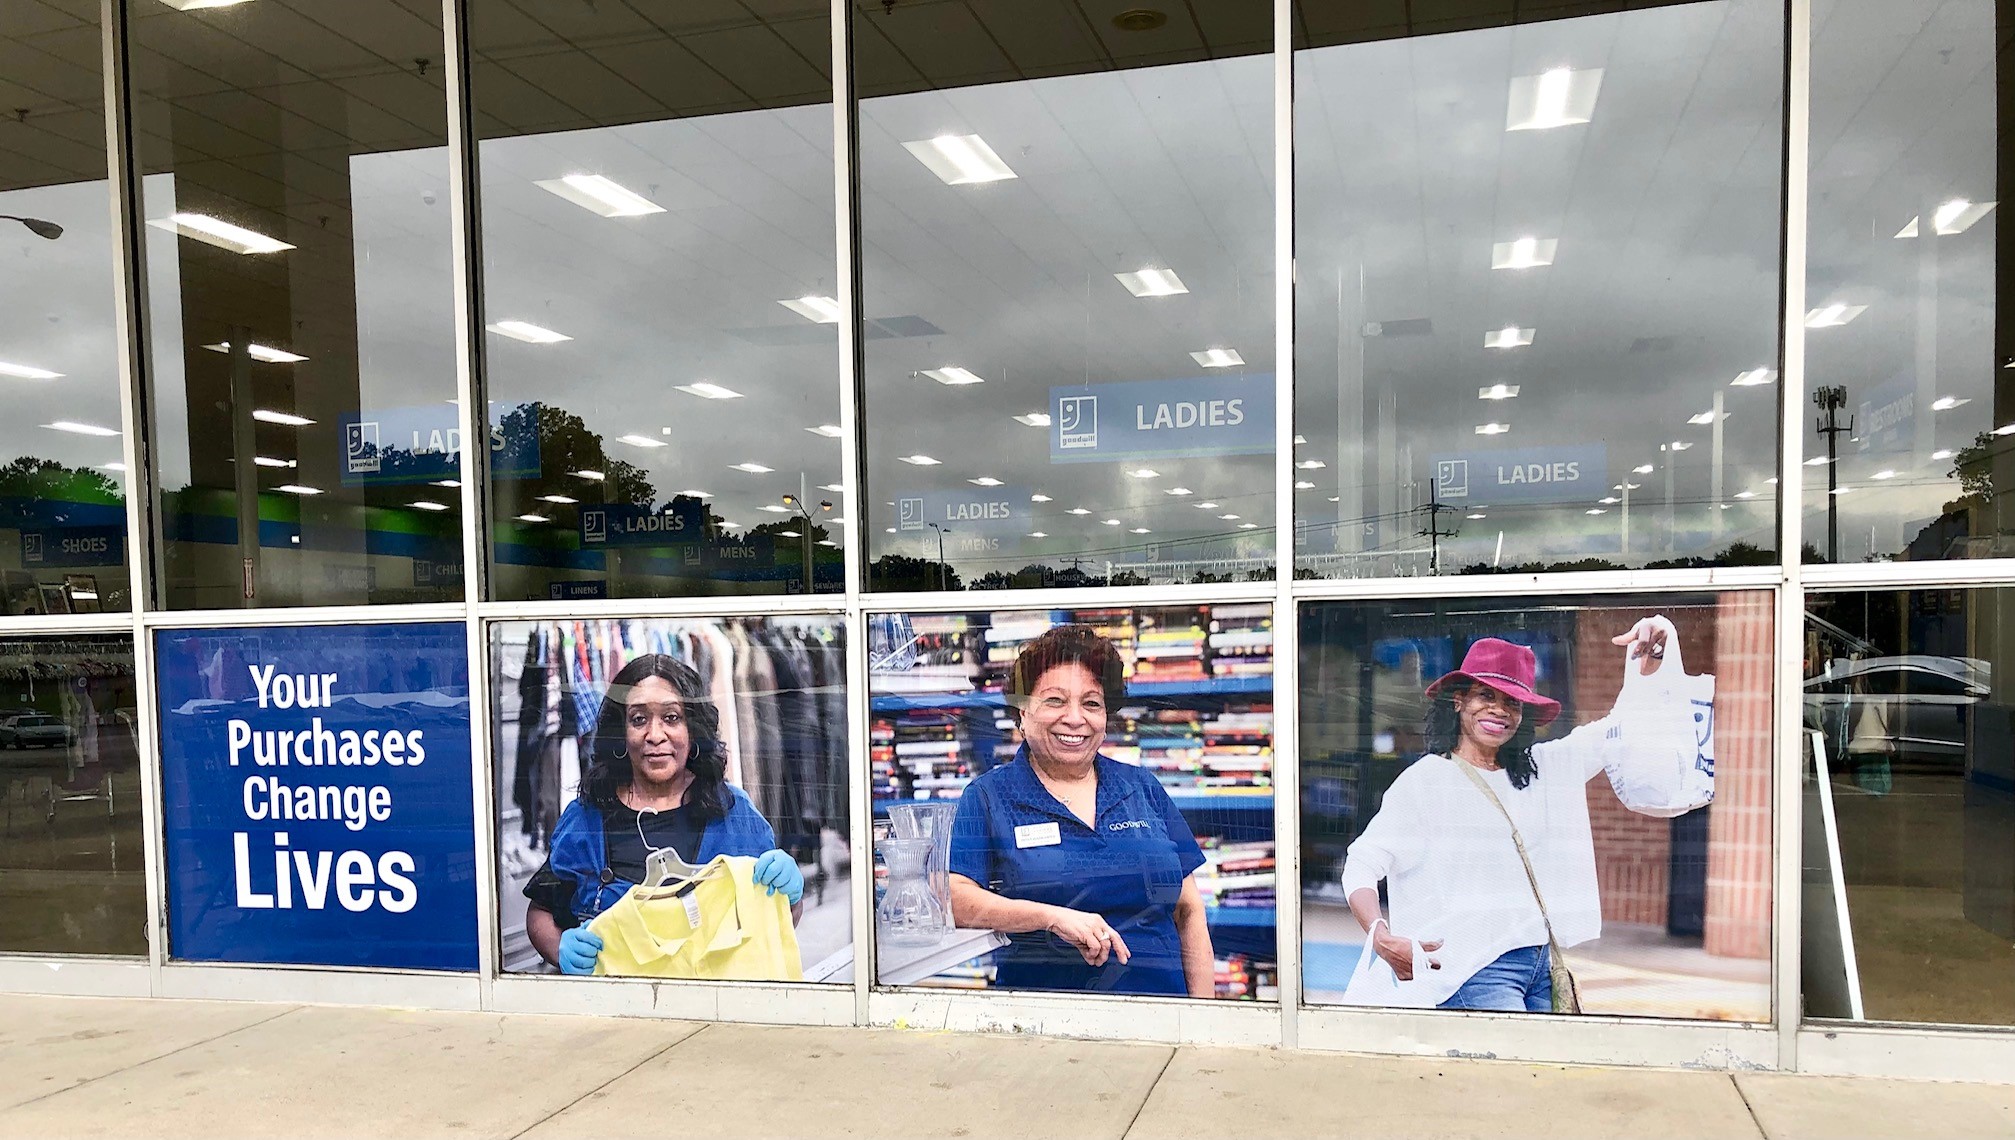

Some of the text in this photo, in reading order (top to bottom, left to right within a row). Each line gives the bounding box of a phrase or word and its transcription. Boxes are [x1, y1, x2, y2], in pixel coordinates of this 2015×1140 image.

[1136, 399, 1244, 430] LADIES
[413, 424, 506, 456] LADS
[1062, 434, 1095, 447] goodwill
[1497, 461, 1580, 485] LADIES
[946, 502, 1010, 521] LADIES
[626, 514, 684, 533] LADIES
[61, 537, 107, 553] SHOES
[720, 546, 756, 559] MENS
[960, 538, 999, 552] MENS
[570, 586, 598, 595] LINENS
[249, 665, 337, 709] Your
[228, 717, 425, 766] Purchases
[243, 776, 392, 831] Change
[233, 832, 418, 913] Lives
